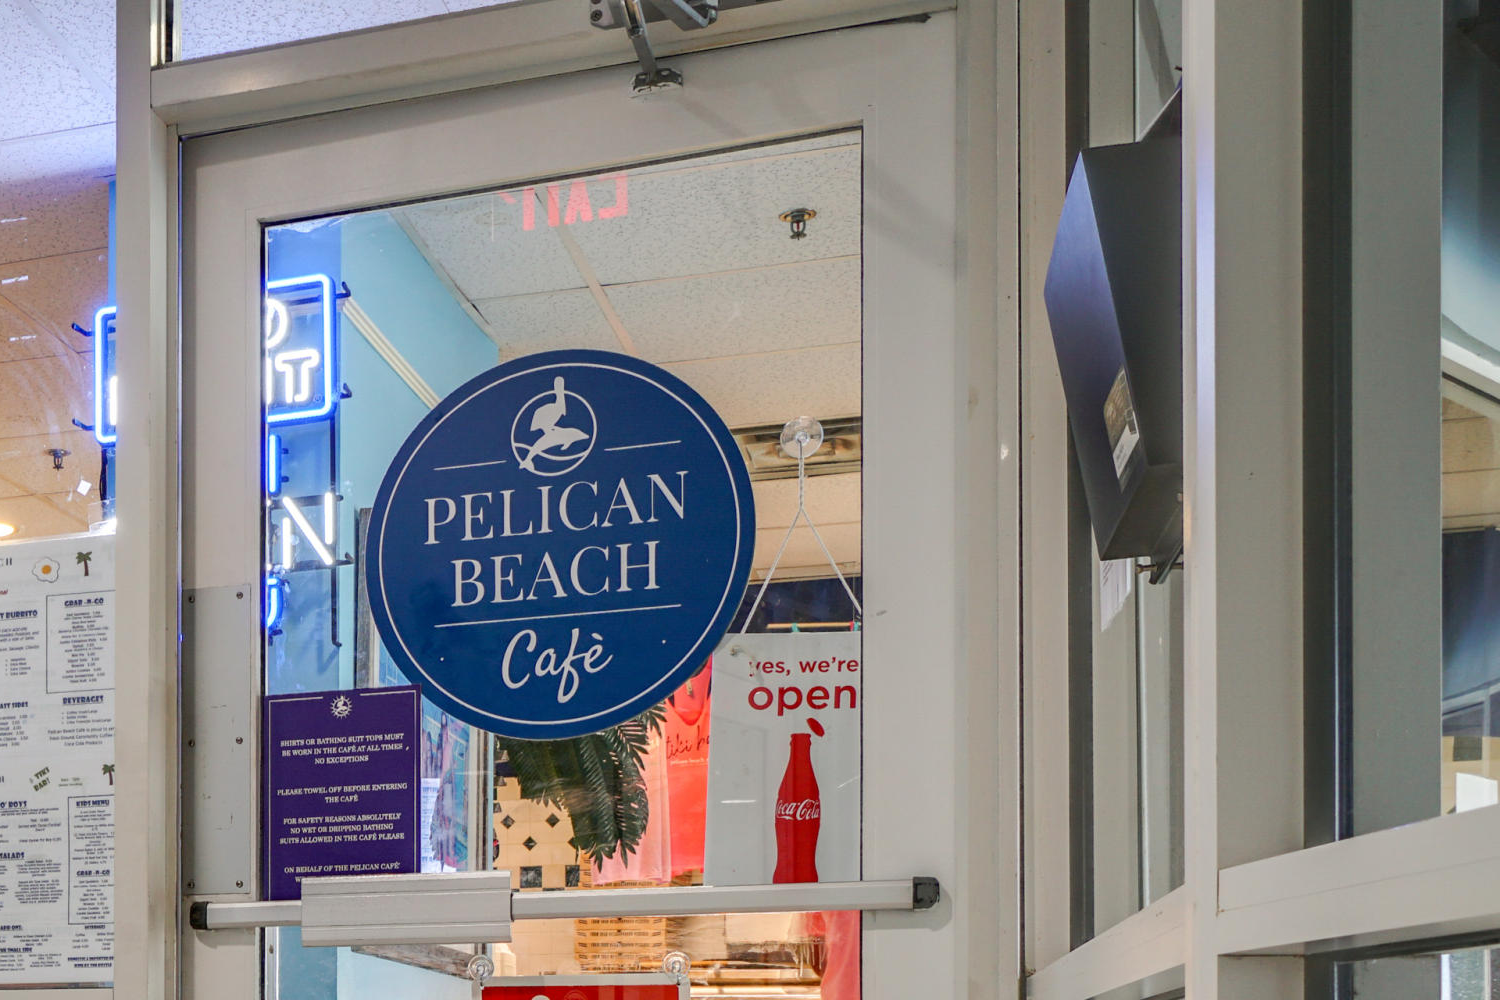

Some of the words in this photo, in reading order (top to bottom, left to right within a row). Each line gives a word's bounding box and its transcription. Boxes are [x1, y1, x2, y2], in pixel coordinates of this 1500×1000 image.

[424, 470, 689, 545] PELICAN
[450, 540, 660, 608] BEACH
[5, 609, 38, 620] BURRITO
[799, 656, 859, 674] we're
[62, 695, 104, 705] BEVERAGES
[748, 684, 857, 717] open
[280, 739, 305, 748] SHIRTS
[306, 738, 315, 746] OR
[317, 737, 347, 745] BATHING
[348, 735, 365, 743] SUIT
[384, 733, 404, 741] MUST
[282, 749, 291, 757] BE
[292, 748, 312, 756] WORN
[313, 747, 321, 755] IN
[326, 755, 369, 764] EXCEPTIONS
[277, 788, 302, 796] PLEASE
[304, 787, 327, 795] TOWEL
[328, 785, 342, 793] OFF
[343, 784, 370, 792] BEFORE
[372, 782, 408, 791] ENTERING
[325, 796, 339, 804] THE
[284, 817, 297, 825] FOR
[298, 816, 324, 824] SAFETY
[325, 815, 356, 823] REASONS
[357, 812, 402, 822] ABSOLUTELY
[317, 825, 327, 833] OR
[328, 824, 361, 833] DRIPPING
[363, 823, 394, 831] BATHING
[279, 837, 299, 845] SUITS
[300, 835, 332, 844] ALLOWED
[343, 834, 358, 842] THE
[378, 832, 405, 840] PLEASE
[284, 865, 295, 873] ON
[296, 864, 322, 873] BEHALF
[323, 864, 332, 872] OF
[350, 863, 379, 871] PELICAN
